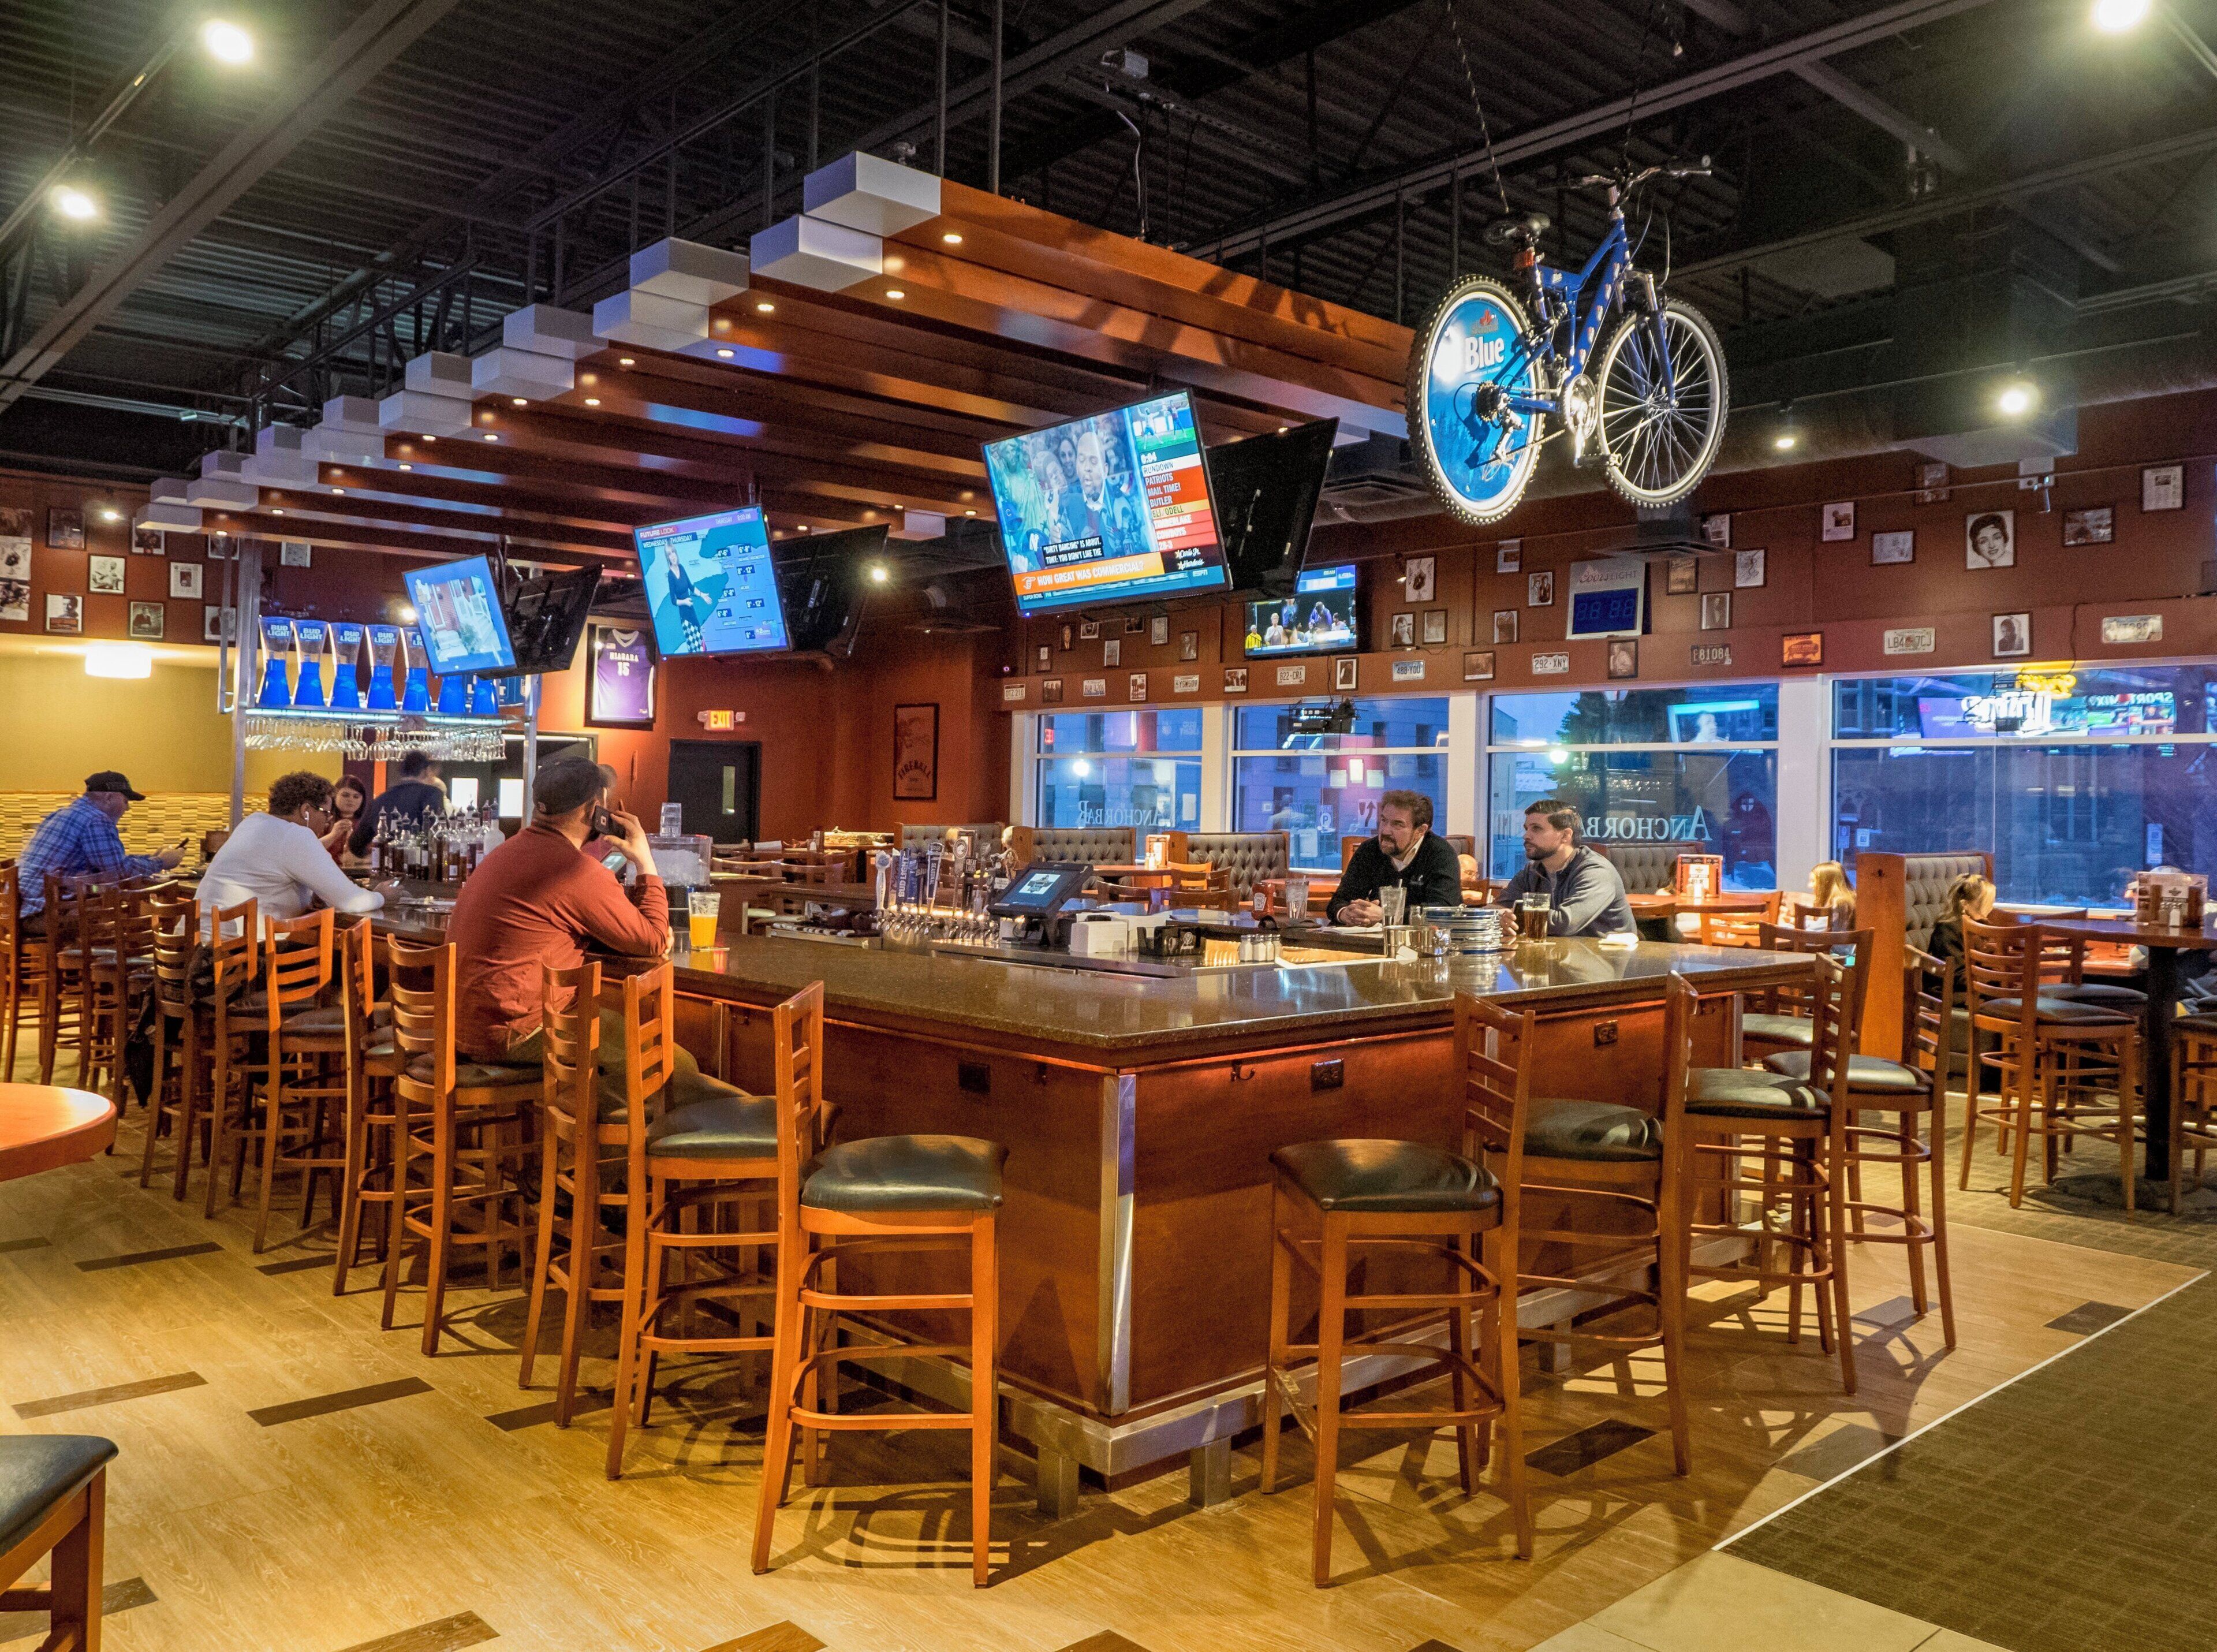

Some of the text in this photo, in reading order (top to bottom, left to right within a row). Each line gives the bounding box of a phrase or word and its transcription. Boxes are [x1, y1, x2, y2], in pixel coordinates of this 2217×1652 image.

[1465, 336, 1505, 374] Blue
[1144, 463, 1174, 473] RUNDOWN
[1145, 473, 1173, 486] PATRIOTS
[1147, 482, 1181, 497] MAIL TIME!
[1150, 495, 1173, 508] BUTLER
[640, 529, 660, 538] FUTURE
[643, 539, 667, 548] WEDNESDAY
[670, 535, 692, 543] THURSDAY
[1037, 561, 1144, 586] HOW GREAT WAS COMMERCIAL?
[1193, 569, 1208, 577] ESPN
[610, 652, 639, 662] NIAGARA
[618, 662, 630, 676] 15
[711, 711, 730, 728] EXIT
[901, 857, 909, 879] LIGHT
